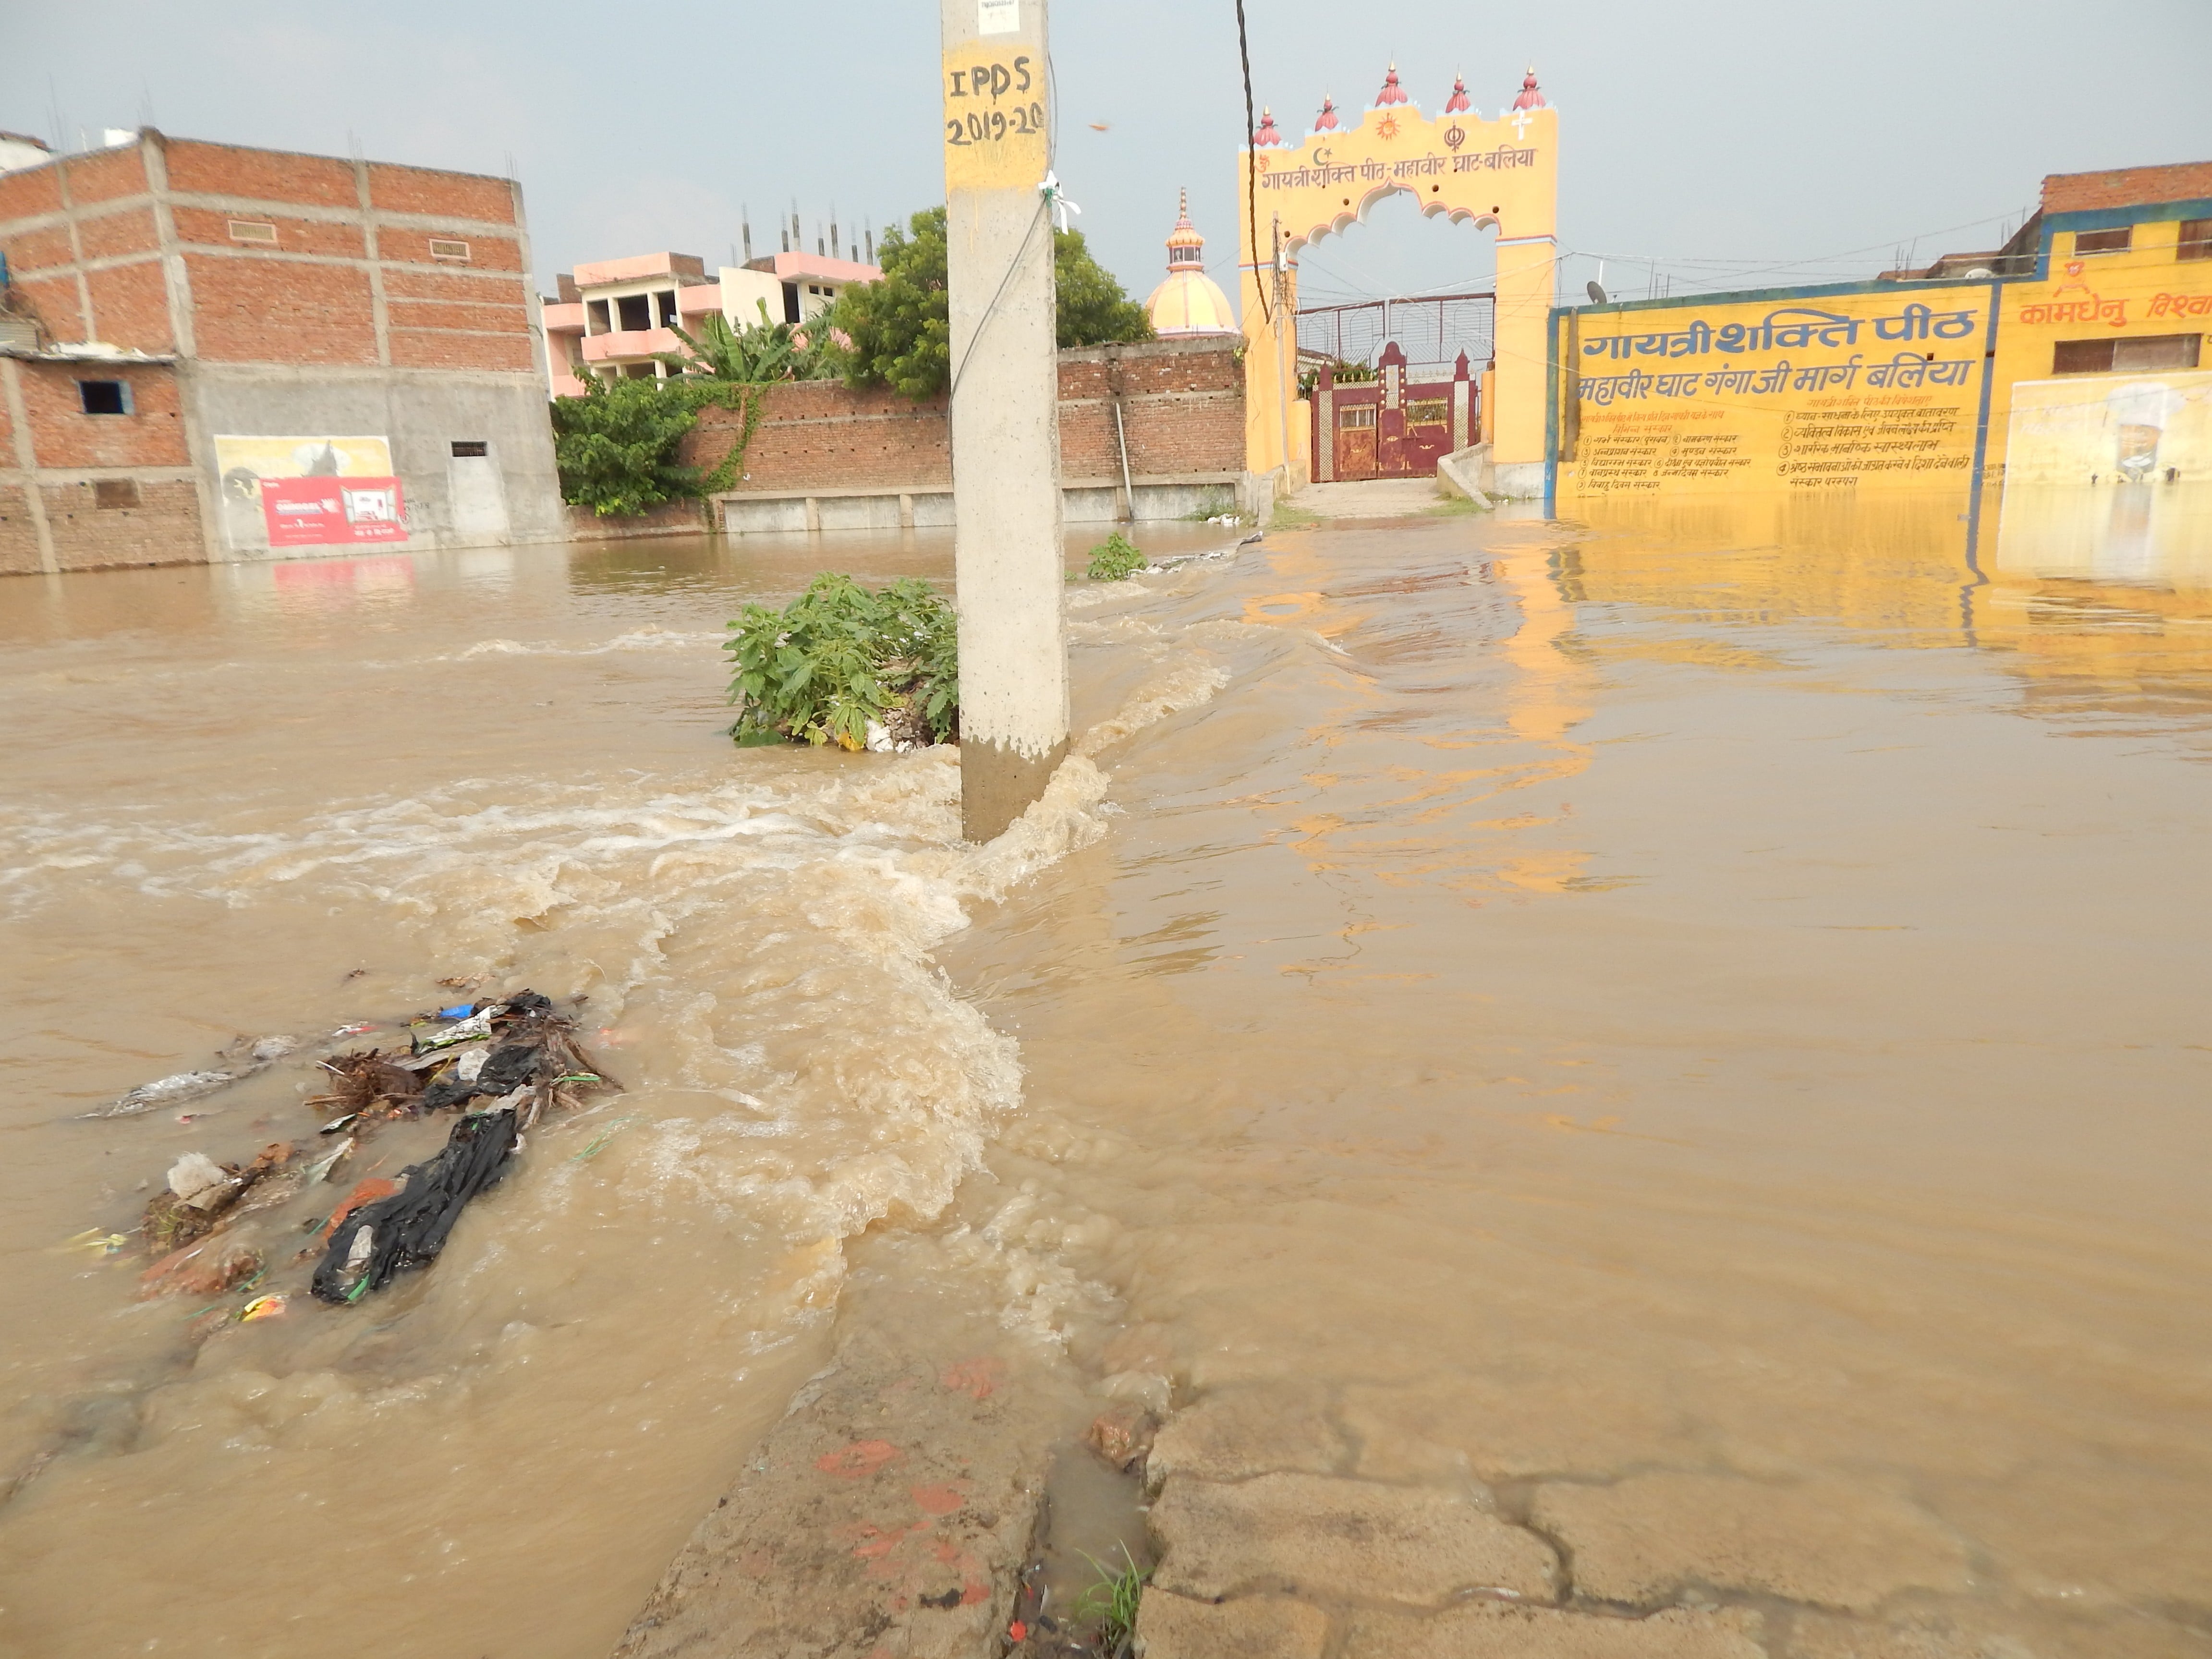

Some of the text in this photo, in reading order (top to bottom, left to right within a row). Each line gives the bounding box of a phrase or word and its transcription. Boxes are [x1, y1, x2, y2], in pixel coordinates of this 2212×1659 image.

[950, 56, 1031, 98] IPDS
[947, 102, 1045, 145] 2019-20
[1262, 165, 1310, 190] गायत्री
[1311, 161, 1357, 186] शक्ति
[1583, 303, 1978, 359] गायत्री शक्ति पीठ
[2020, 293, 2130, 327] कामधेनु
[1578, 352, 1976, 406] महावीर घाट गंगा जी मार्ग बलिया
